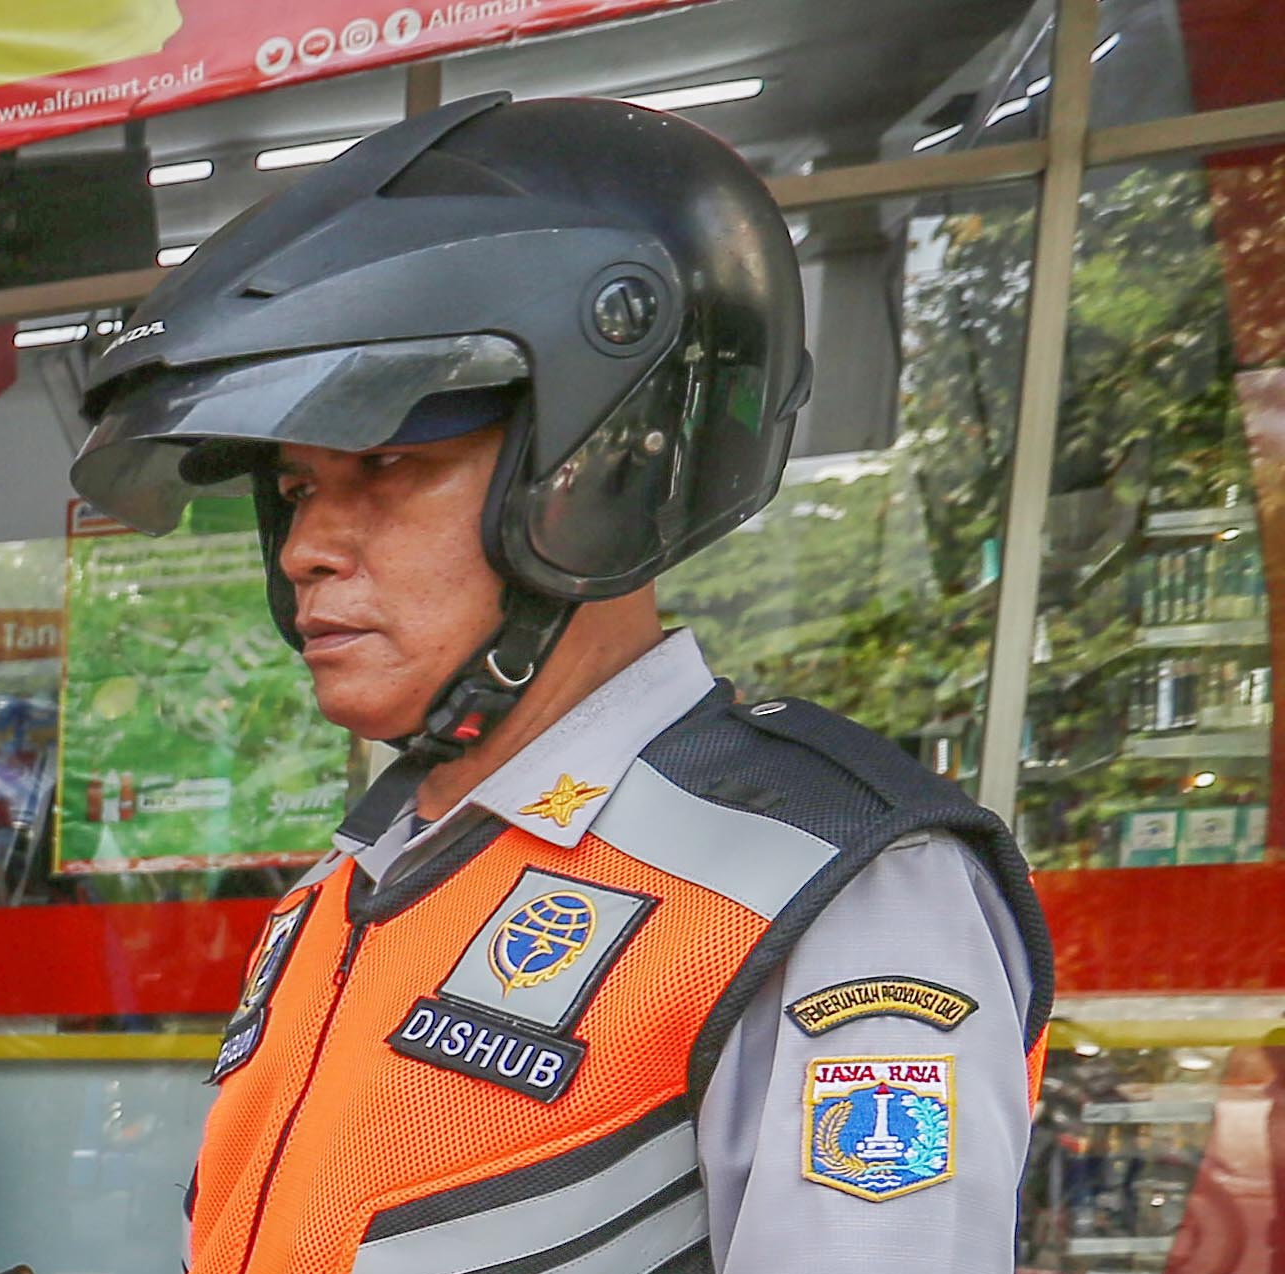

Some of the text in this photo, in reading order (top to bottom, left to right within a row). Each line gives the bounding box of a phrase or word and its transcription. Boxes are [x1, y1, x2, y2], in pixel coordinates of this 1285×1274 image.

[4, 621, 57, 650] Tan
[796, 985, 964, 1028] PEMERINTAH PROVINSI DKI
[402, 1010, 565, 1090] DISHUB
[815, 1065, 941, 1083] JAYA RAYA
